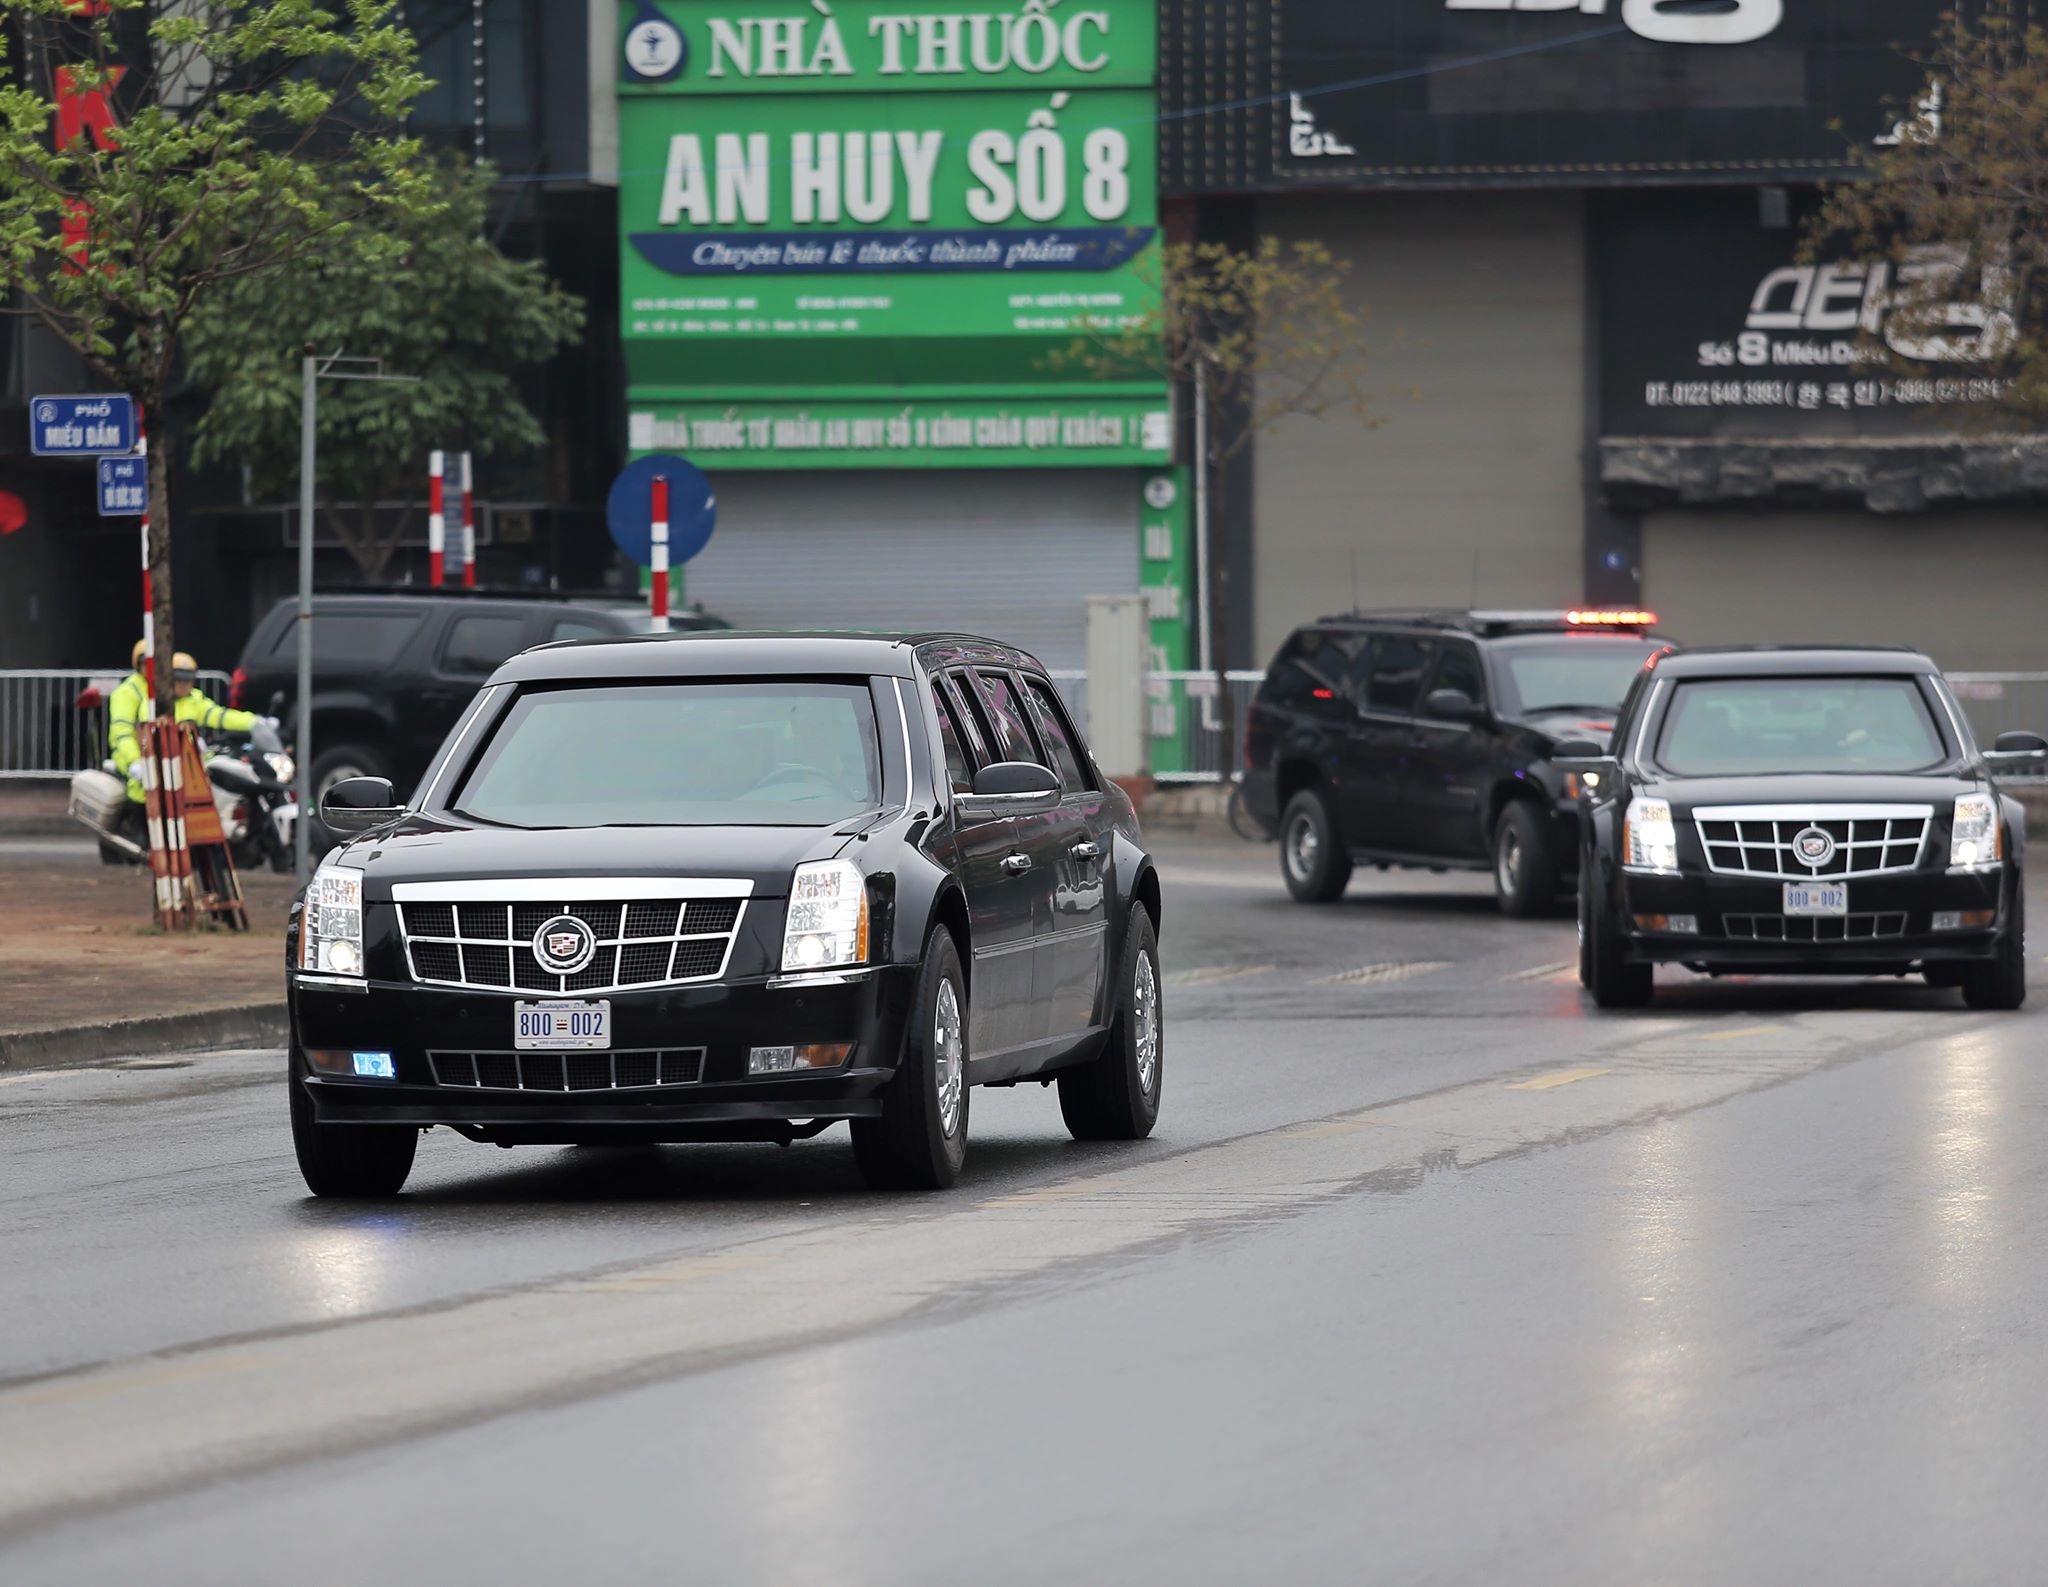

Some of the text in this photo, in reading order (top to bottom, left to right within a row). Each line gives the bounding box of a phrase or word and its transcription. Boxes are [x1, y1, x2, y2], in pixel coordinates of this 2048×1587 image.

[707, 0, 1110, 77] NHÀ THUỐC
[658, 92, 1130, 225] AN HUY SỐ 8
[857, 236, 927, 264] thuốc
[929, 237, 1002, 263] thành
[1737, 331, 1768, 366] 8
[75, 400, 111, 417] PHỐ
[1821, 890, 1842, 907] 002
[521, 1012, 603, 1036] 800 002
